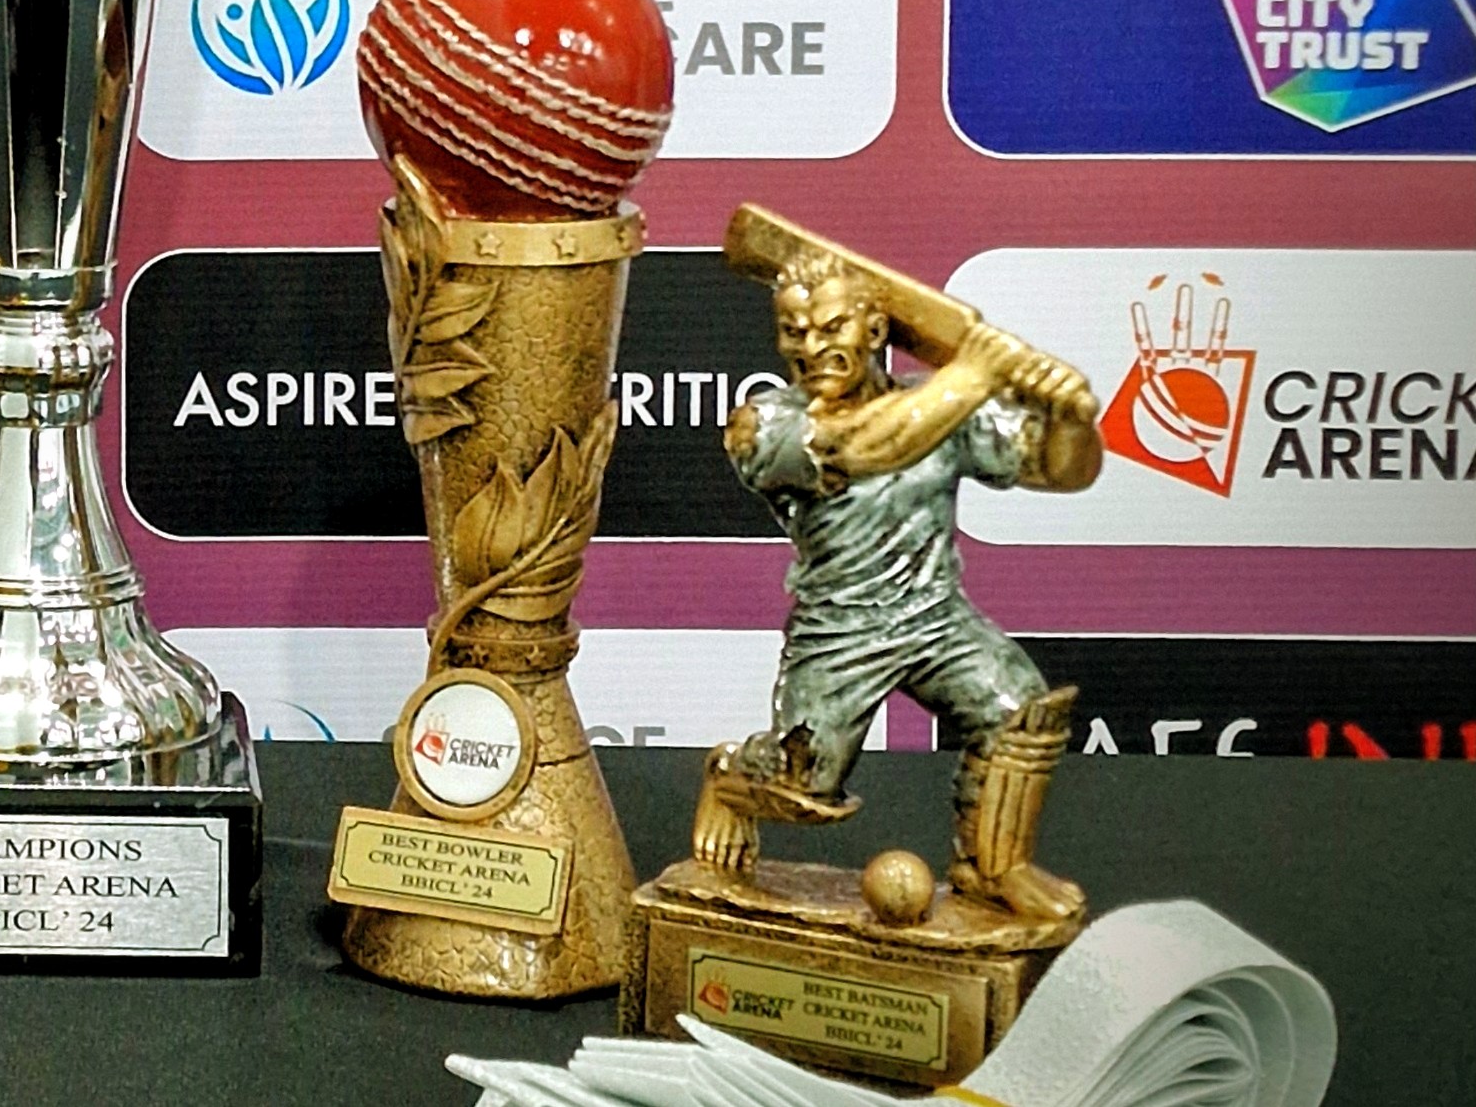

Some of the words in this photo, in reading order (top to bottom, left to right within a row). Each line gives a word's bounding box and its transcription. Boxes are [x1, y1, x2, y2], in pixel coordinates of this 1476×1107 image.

[670, 22, 825, 76] ARE
[1256, 31, 1429, 71] TRUST
[173, 371, 396, 426] ASPIRE
[1262, 428, 1476, 481] AREN
[447, 751, 500, 770] ARENA
[449, 738, 516, 759] CRICKET
[382, 833, 430, 850] BEST
[436, 841, 524, 866] BOWLER
[368, 850, 457, 874] CRICKET
[461, 865, 531, 886] ARENA
[54, 876, 179, 899] ARENA
[731, 1002, 784, 1021] ARENA
[732, 989, 795, 1011] CRICKET
[803, 981, 843, 1001] BEST
[847, 989, 928, 1015] BATSMAN
[803, 1002, 869, 1026] CRICKET
[873, 1017, 926, 1037] ARENA
